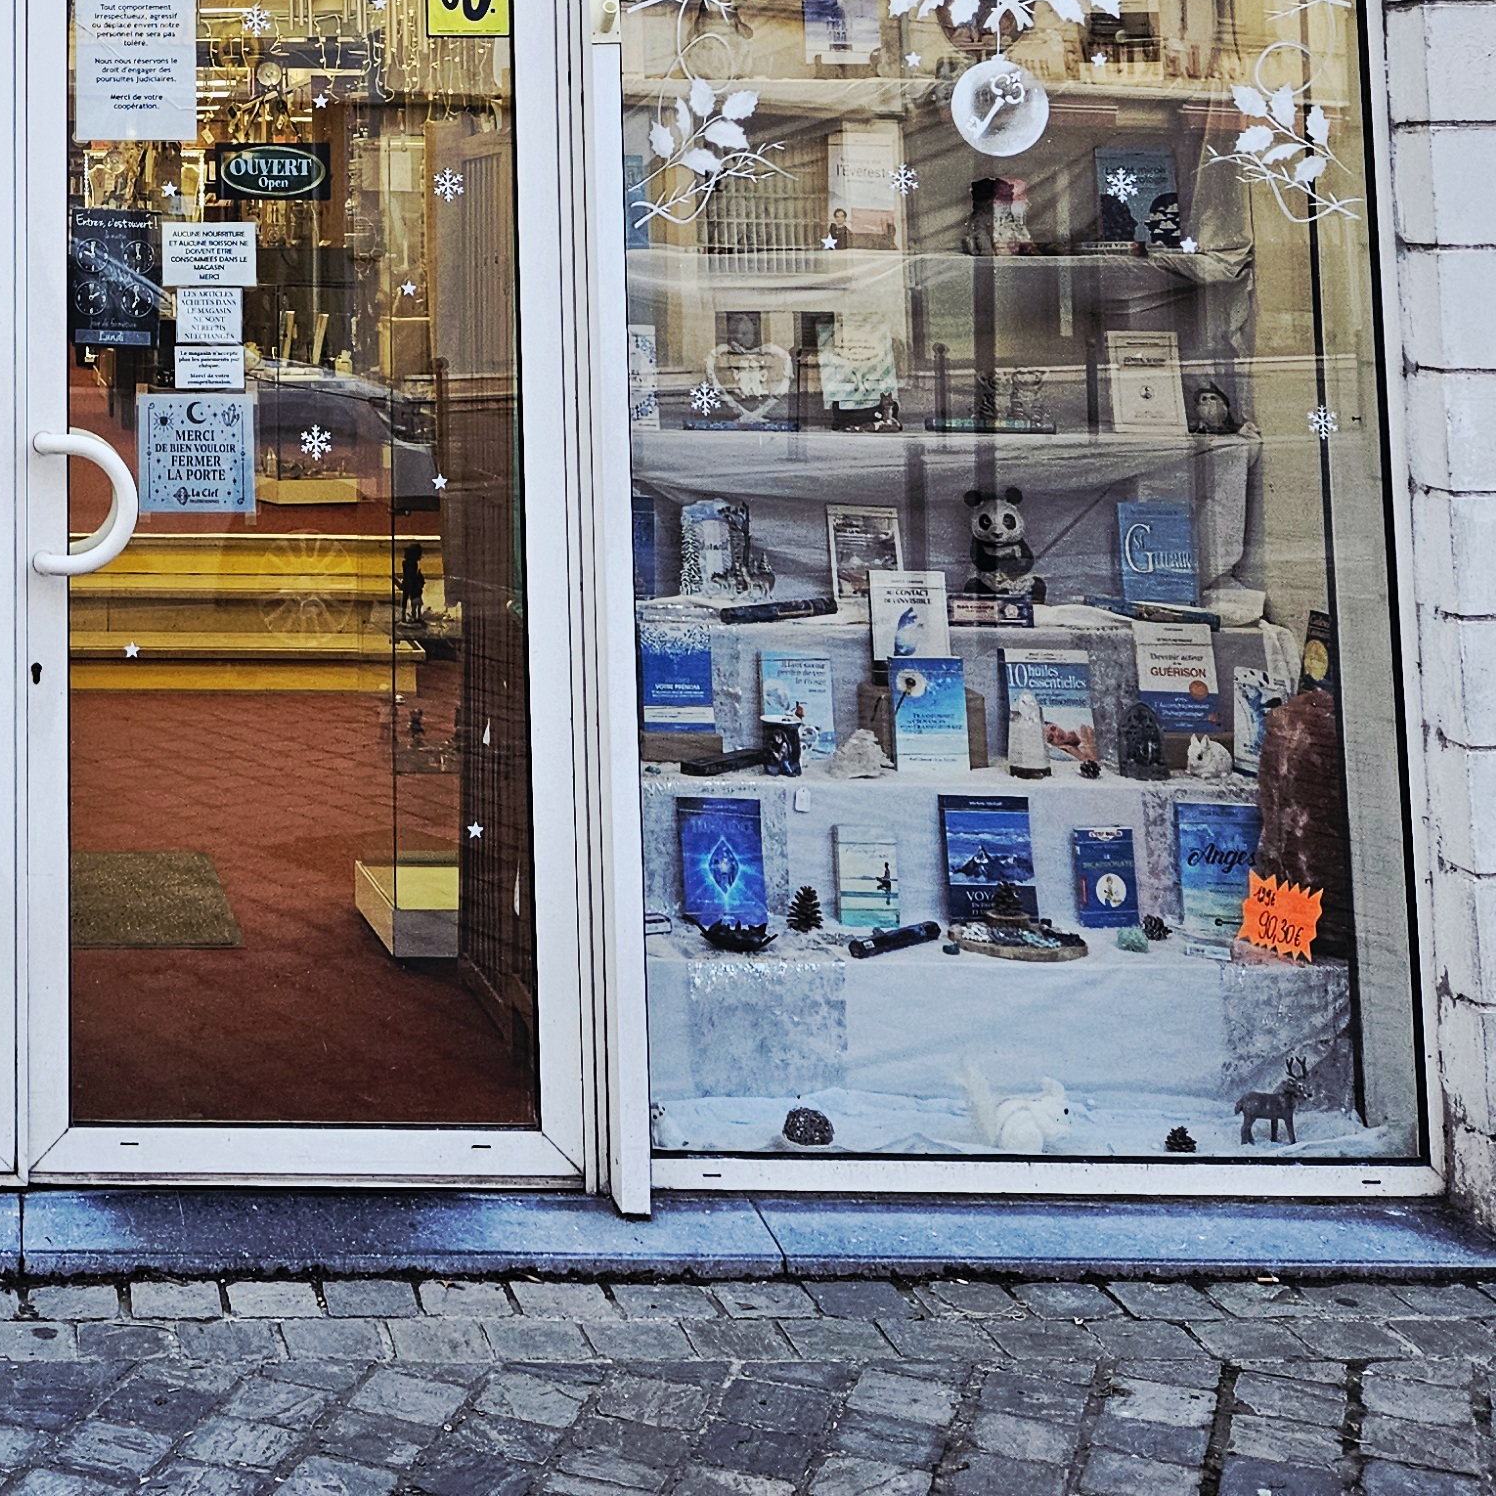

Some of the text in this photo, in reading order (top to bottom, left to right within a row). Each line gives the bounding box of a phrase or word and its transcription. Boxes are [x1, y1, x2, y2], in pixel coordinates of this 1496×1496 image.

[117, 4, 172, 12] comportement
[94, 12, 178, 21] irrespectueux, agressif
[96, 31, 133, 39] personnel
[121, 66, 156, 75] d'engager
[96, 75, 177, 84] poursuites judiciaires.
[113, 102, 160, 110] coopération.
[229, 158, 312, 176] OUVERT
[258, 176, 289, 191] Open
[175, 429, 215, 442] MERCI
[155, 444, 236, 453] DE BIEN VOULOIR
[171, 455, 221, 467] FERMER
[167, 469, 226, 481] LA PORTE
[191, 488, 219, 498] La Clef
[1149, 652, 1178, 661] Devenir
[1006, 663, 1059, 687] 10 huiles
[1028, 676, 1086, 689] essentielles
[1187, 842, 1255, 874] Anges
[1258, 910, 1304, 947] 90,30€
